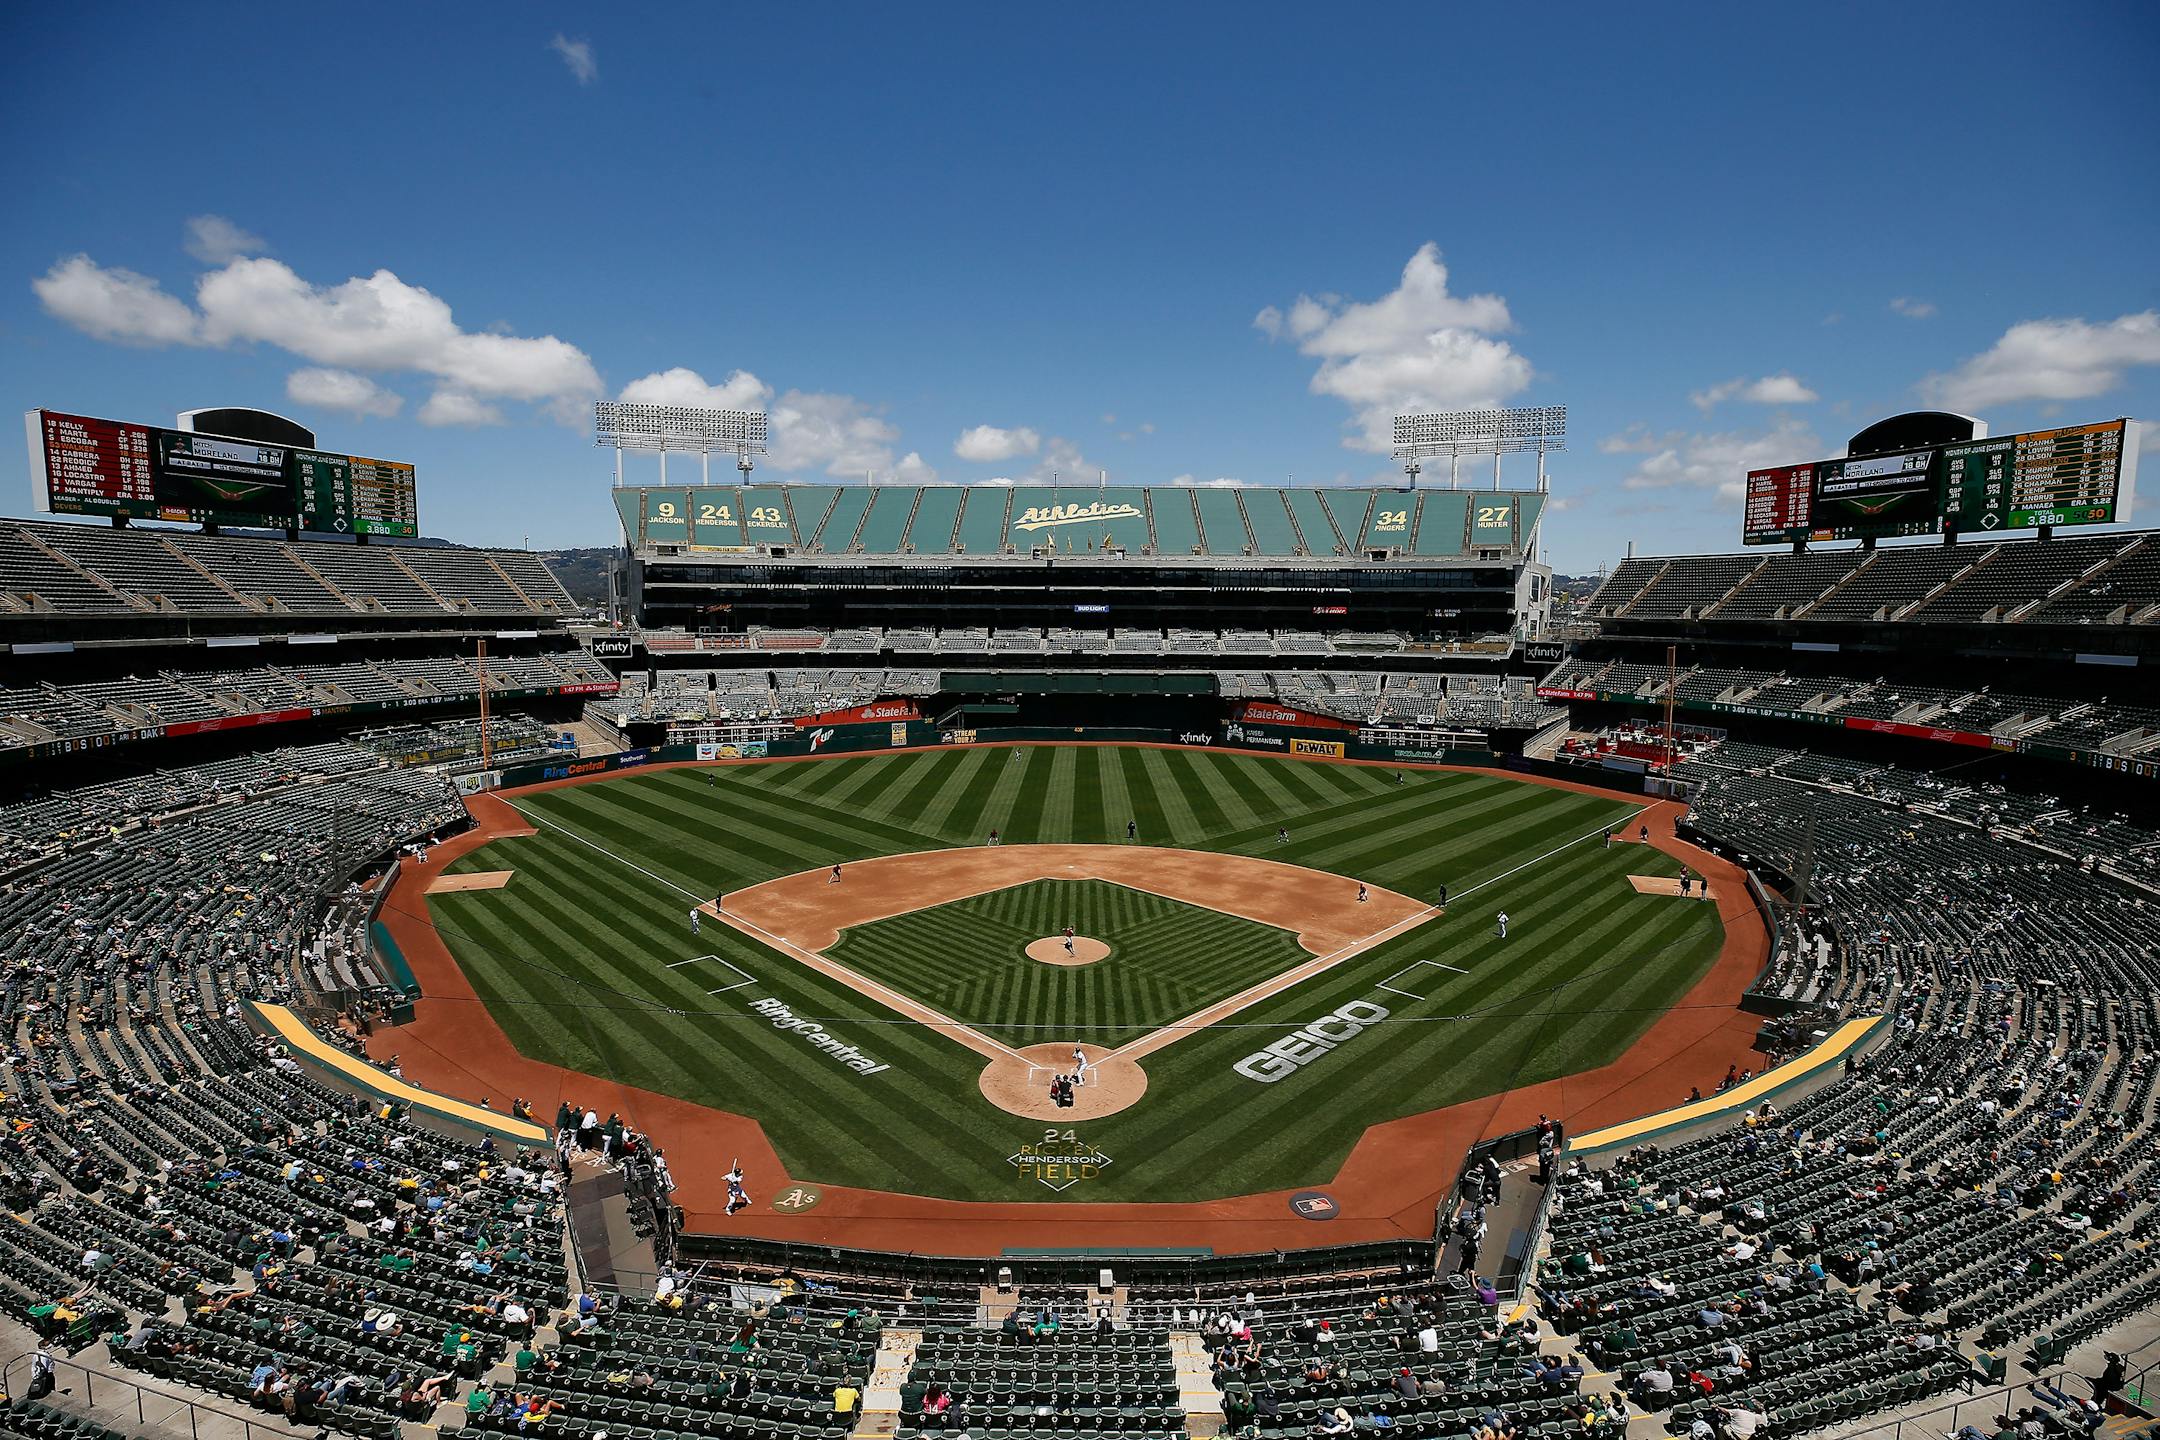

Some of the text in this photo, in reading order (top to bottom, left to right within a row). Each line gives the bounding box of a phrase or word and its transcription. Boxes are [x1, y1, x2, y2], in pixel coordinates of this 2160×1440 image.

[59, 421, 84, 430] KELLY
[59, 429, 88, 438] MARTE
[60, 436, 98, 446] ESCOBAR
[2027, 439, 2055, 447] CANHA
[60, 443, 95, 453] WALKER
[2027, 445, 2057, 454] LOWRIE
[62, 449, 100, 460] CABRERA
[194, 449, 239, 460] MORELAND
[2026, 453, 2052, 461] OLSON
[51, 455, 62, 463] 22
[63, 457, 98, 467] REDDICK
[1904, 461, 1914, 469] 18
[63, 464, 93, 473] AHMED
[1845, 468, 1884, 478] MORELAND
[2025, 466, 2058, 475] MURPHY
[64, 471, 105, 481] LOCASTRO
[2025, 473, 2054, 482] BROWN
[64, 479, 97, 488] VARGAS
[2024, 479, 2063, 488] CHAPMAN
[65, 487, 104, 496] MANTIPLY
[117, 491, 132, 499] ERA
[2023, 487, 2046, 495] KEMP
[2022, 493, 2055, 502] ANDRUS
[2021, 501, 2055, 511] MANAEA
[2071, 499, 2088, 507] ERA
[2092, 497, 2111, 505] 3.22
[658, 502, 675, 518] 9
[700, 504, 731, 520] 24
[751, 506, 781, 522] 43
[1013, 502, 1141, 528] Athletics
[1477, 506, 1510, 522] 27
[648, 516, 685, 525] JACKSON
[695, 518, 738, 527] HENDERSON
[1376, 510, 1408, 526] 34
[2027, 513, 2065, 526] 3,880
[747, 520, 788, 529] ECKERSLEY
[1374, 524, 1406, 532] FINGERS
[1477, 521, 1508, 529] HUNTER
[366, 525, 390, 535] 3,880
[594, 641, 629, 654] xfinity
[1527, 646, 1561, 659] xfinity
[312, 705, 352, 716] 35 MANTIPLY
[1247, 707, 1297, 722] StateFarm
[140, 729, 159, 740] OAK
[954, 729, 977, 737] STREAM
[1180, 731, 1212, 745] xfinity
[1246, 729, 1265, 737] KAISER
[544, 759, 608, 779] RingCentral
[747, 997, 891, 1076] RingCentral
[1232, 1000, 1390, 1083] GEICO
[1043, 1128, 1077, 1143] 24
[1020, 1144, 1101, 1155] RICKEY
[1018, 1155, 1102, 1164] HENDERSON
[1017, 1164, 1100, 1179] FIELD
[774, 1188, 816, 1209] A's
